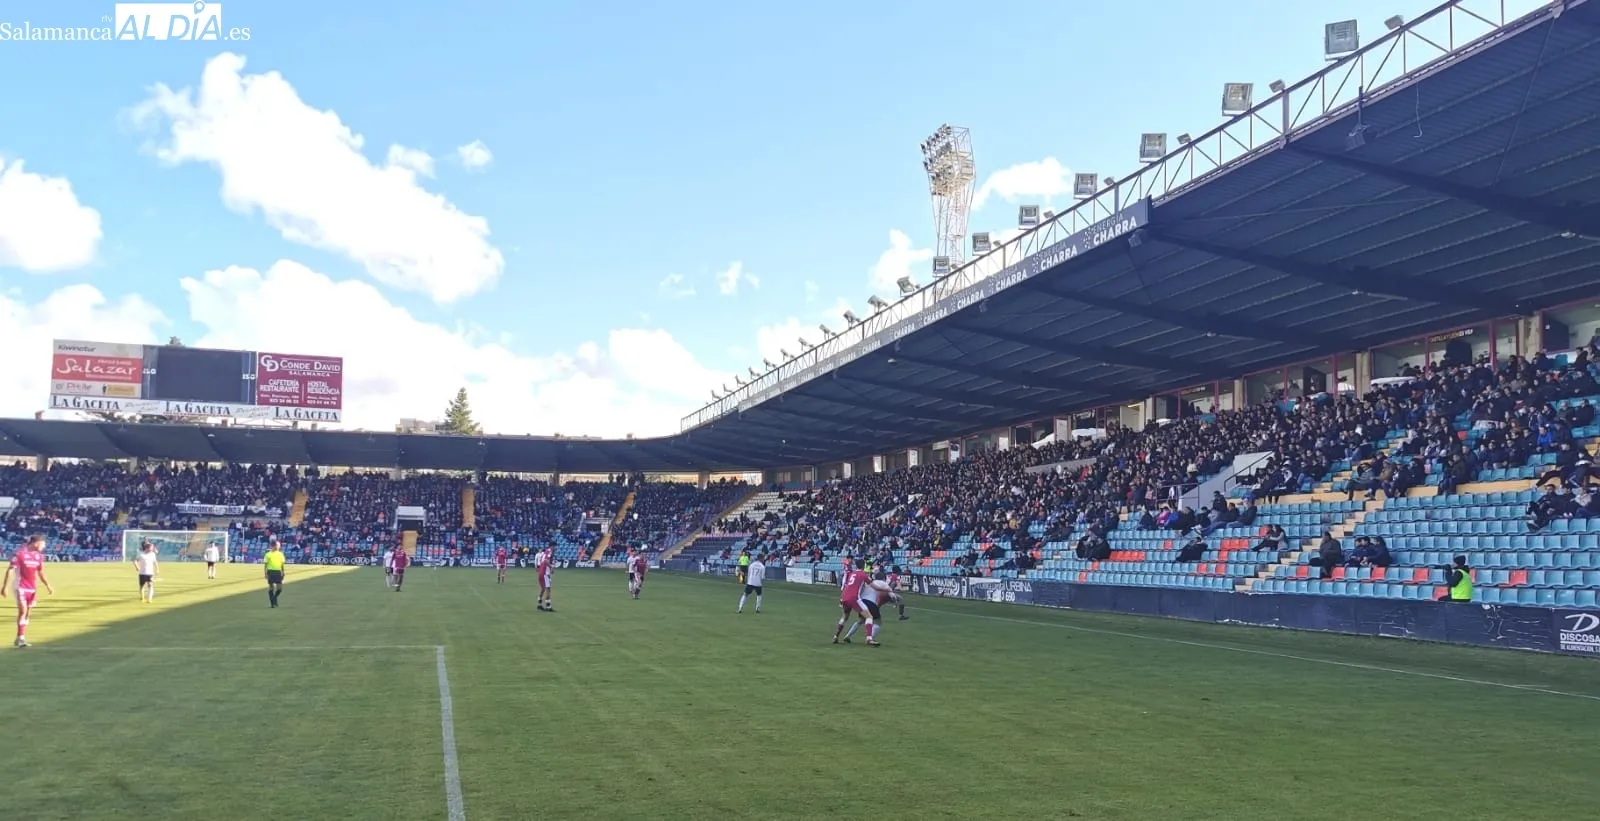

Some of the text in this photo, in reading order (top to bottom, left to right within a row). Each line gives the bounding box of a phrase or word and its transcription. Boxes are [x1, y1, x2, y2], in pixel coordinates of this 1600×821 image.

[1093, 216, 1137, 245] CHARRA
[1040, 245, 1078, 270] CHARRA
[995, 270, 1027, 291] CHARRA
[957, 289, 985, 310] CHARRA
[923, 307, 948, 325] CHARRA
[56, 358, 136, 375] Salazar
[280, 360, 341, 372] CONDE DAVID
[260, 385, 300, 393] RESTAURANTE
[72, 396, 120, 410] GACETA
[184, 401, 231, 415] GACETA
[294, 408, 338, 420] GACETA
[847, 574, 857, 586] 5
